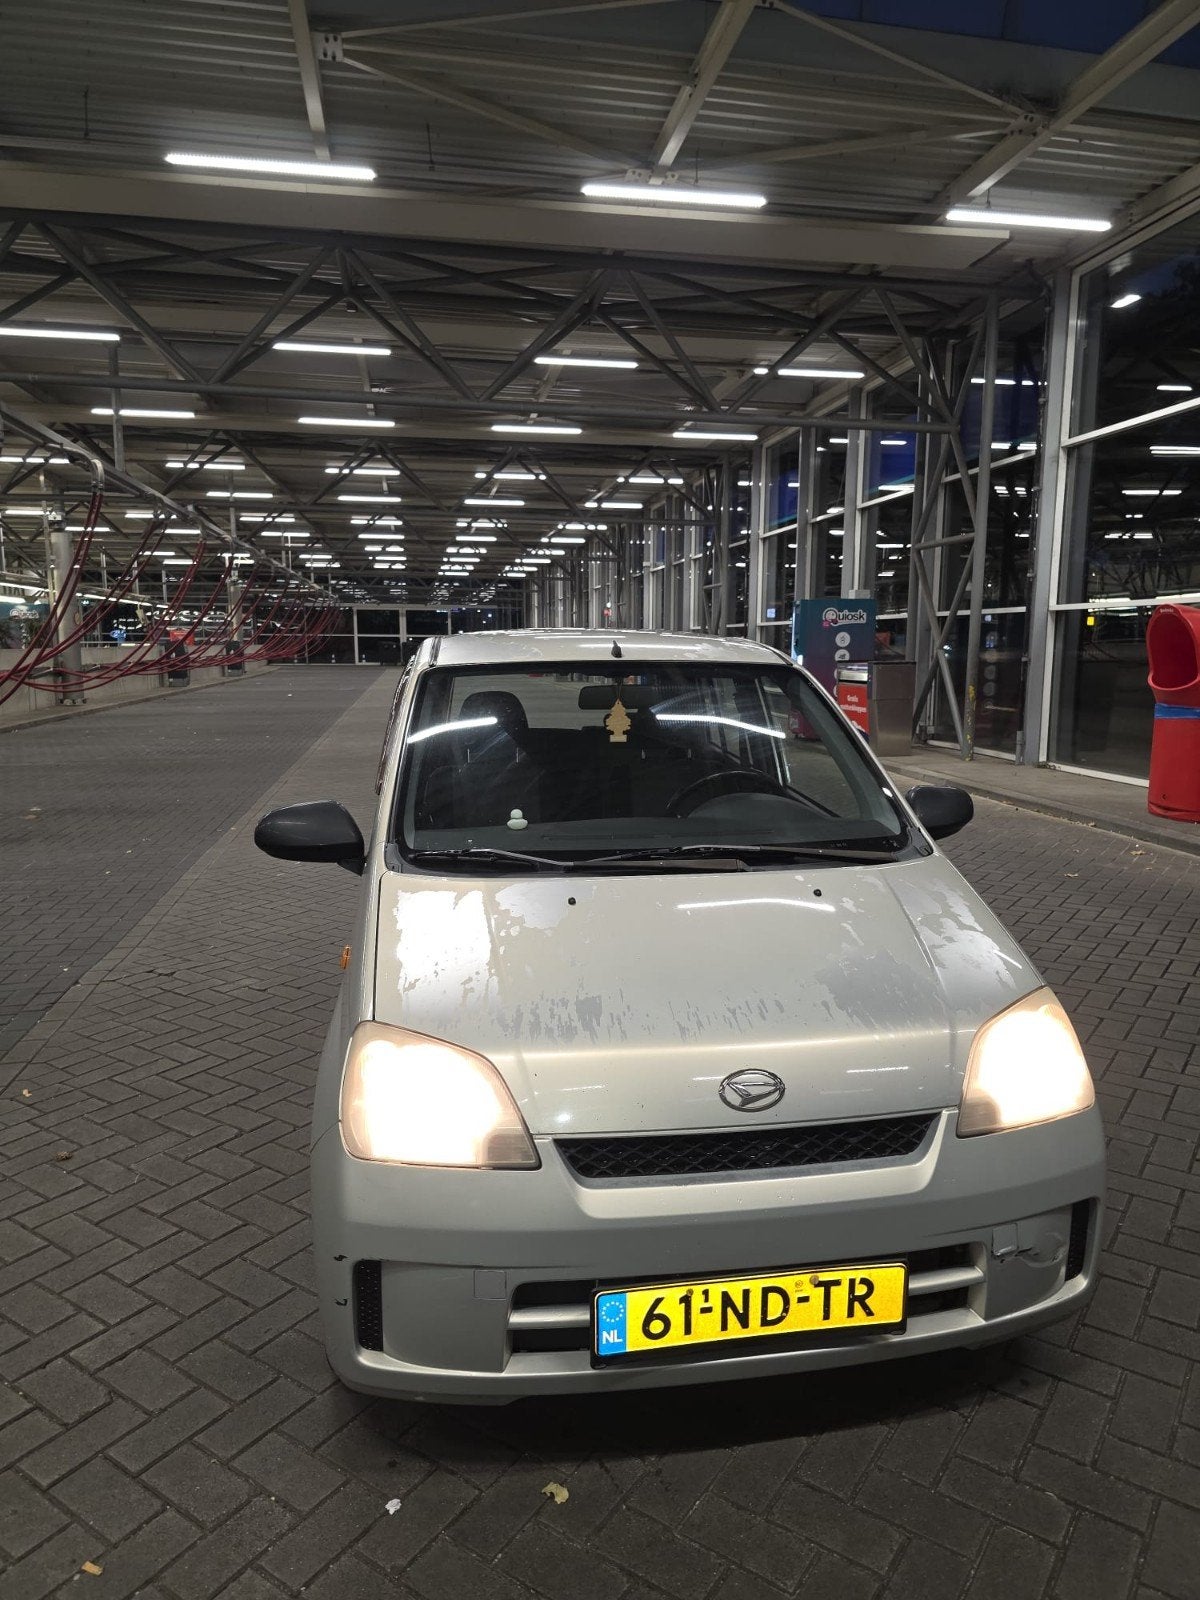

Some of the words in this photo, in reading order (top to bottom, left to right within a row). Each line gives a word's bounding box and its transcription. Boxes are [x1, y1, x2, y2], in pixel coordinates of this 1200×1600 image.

[823, 608, 866, 625] Quiosk
[641, 1277, 876, 1341] 61-ND-TR
[602, 1329, 623, 1345] NL
